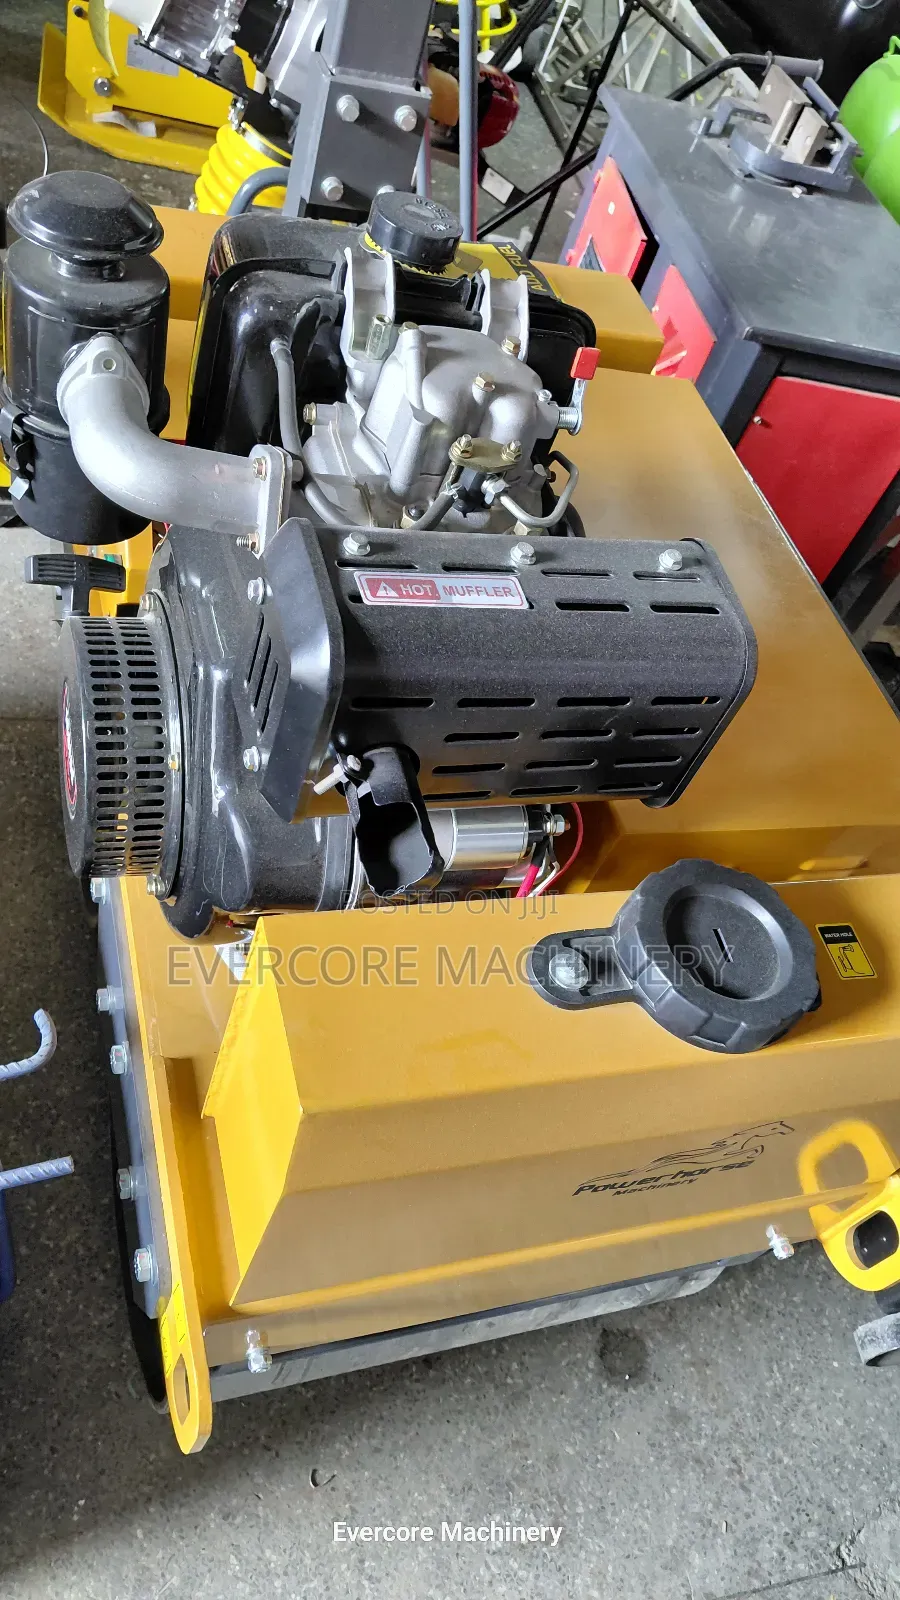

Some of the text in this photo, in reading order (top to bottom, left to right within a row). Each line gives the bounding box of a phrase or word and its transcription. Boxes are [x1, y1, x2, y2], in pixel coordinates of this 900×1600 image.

[497, 244, 528, 267] FUEL
[400, 584, 514, 598] HOT MUFFLER
[572, 1160, 756, 1196] Powerhorse
[612, 1178, 699, 1197] Machinery
